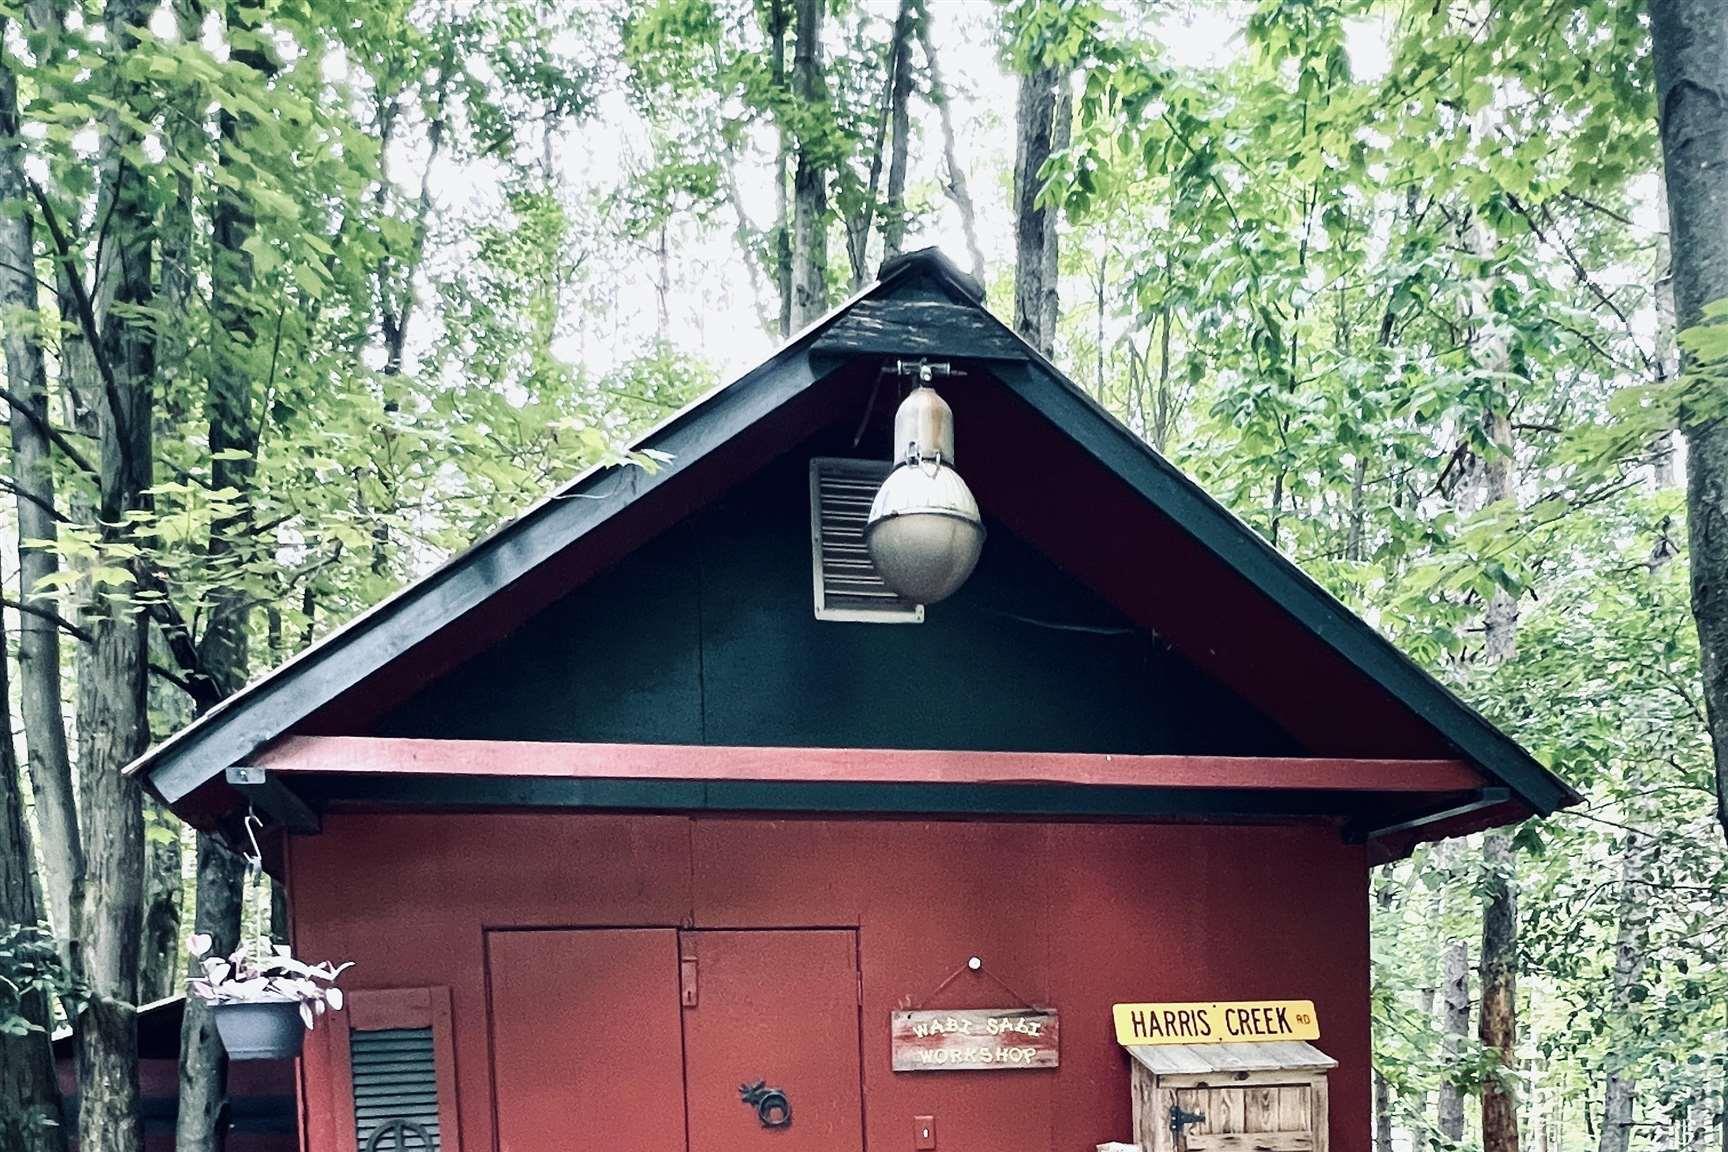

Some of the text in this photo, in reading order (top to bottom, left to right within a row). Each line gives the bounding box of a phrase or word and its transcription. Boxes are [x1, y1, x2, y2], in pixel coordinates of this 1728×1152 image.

[912, 1016, 972, 1038] WABI
[1131, 1007, 1311, 1037] HARRIS CREEK RD
[920, 1047, 1037, 1064] WORKSHOP
